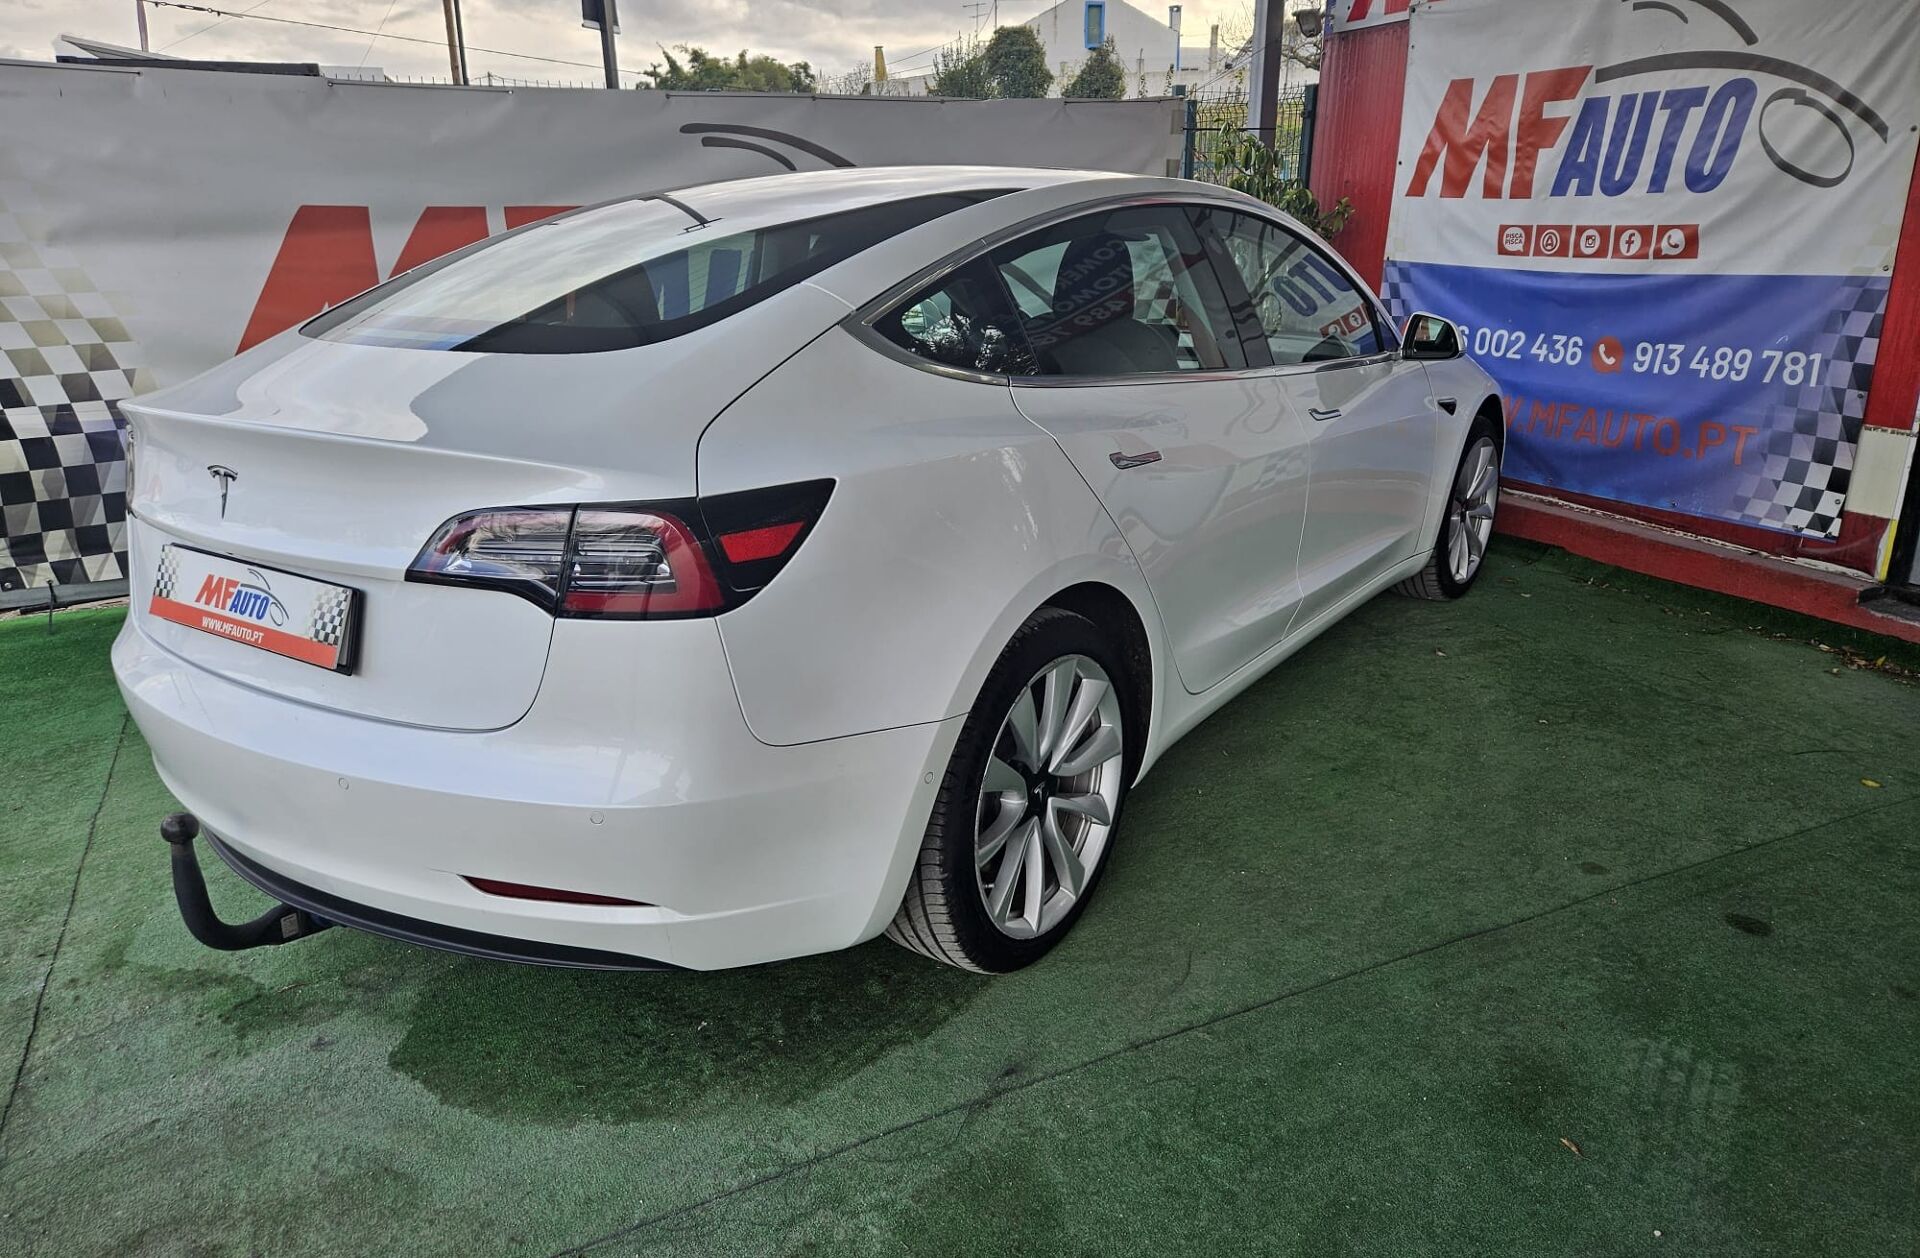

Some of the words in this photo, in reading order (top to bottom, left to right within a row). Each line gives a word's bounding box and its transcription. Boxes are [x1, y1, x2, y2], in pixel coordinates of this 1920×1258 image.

[1474, 327, 1526, 360] 002
[1530, 333, 1583, 366] 436
[1633, 342, 1686, 376] 913
[1689, 346, 1752, 381] 489
[1762, 350, 1822, 388] 781
[202, 616, 264, 644] WWW.MFAUTO.PT
